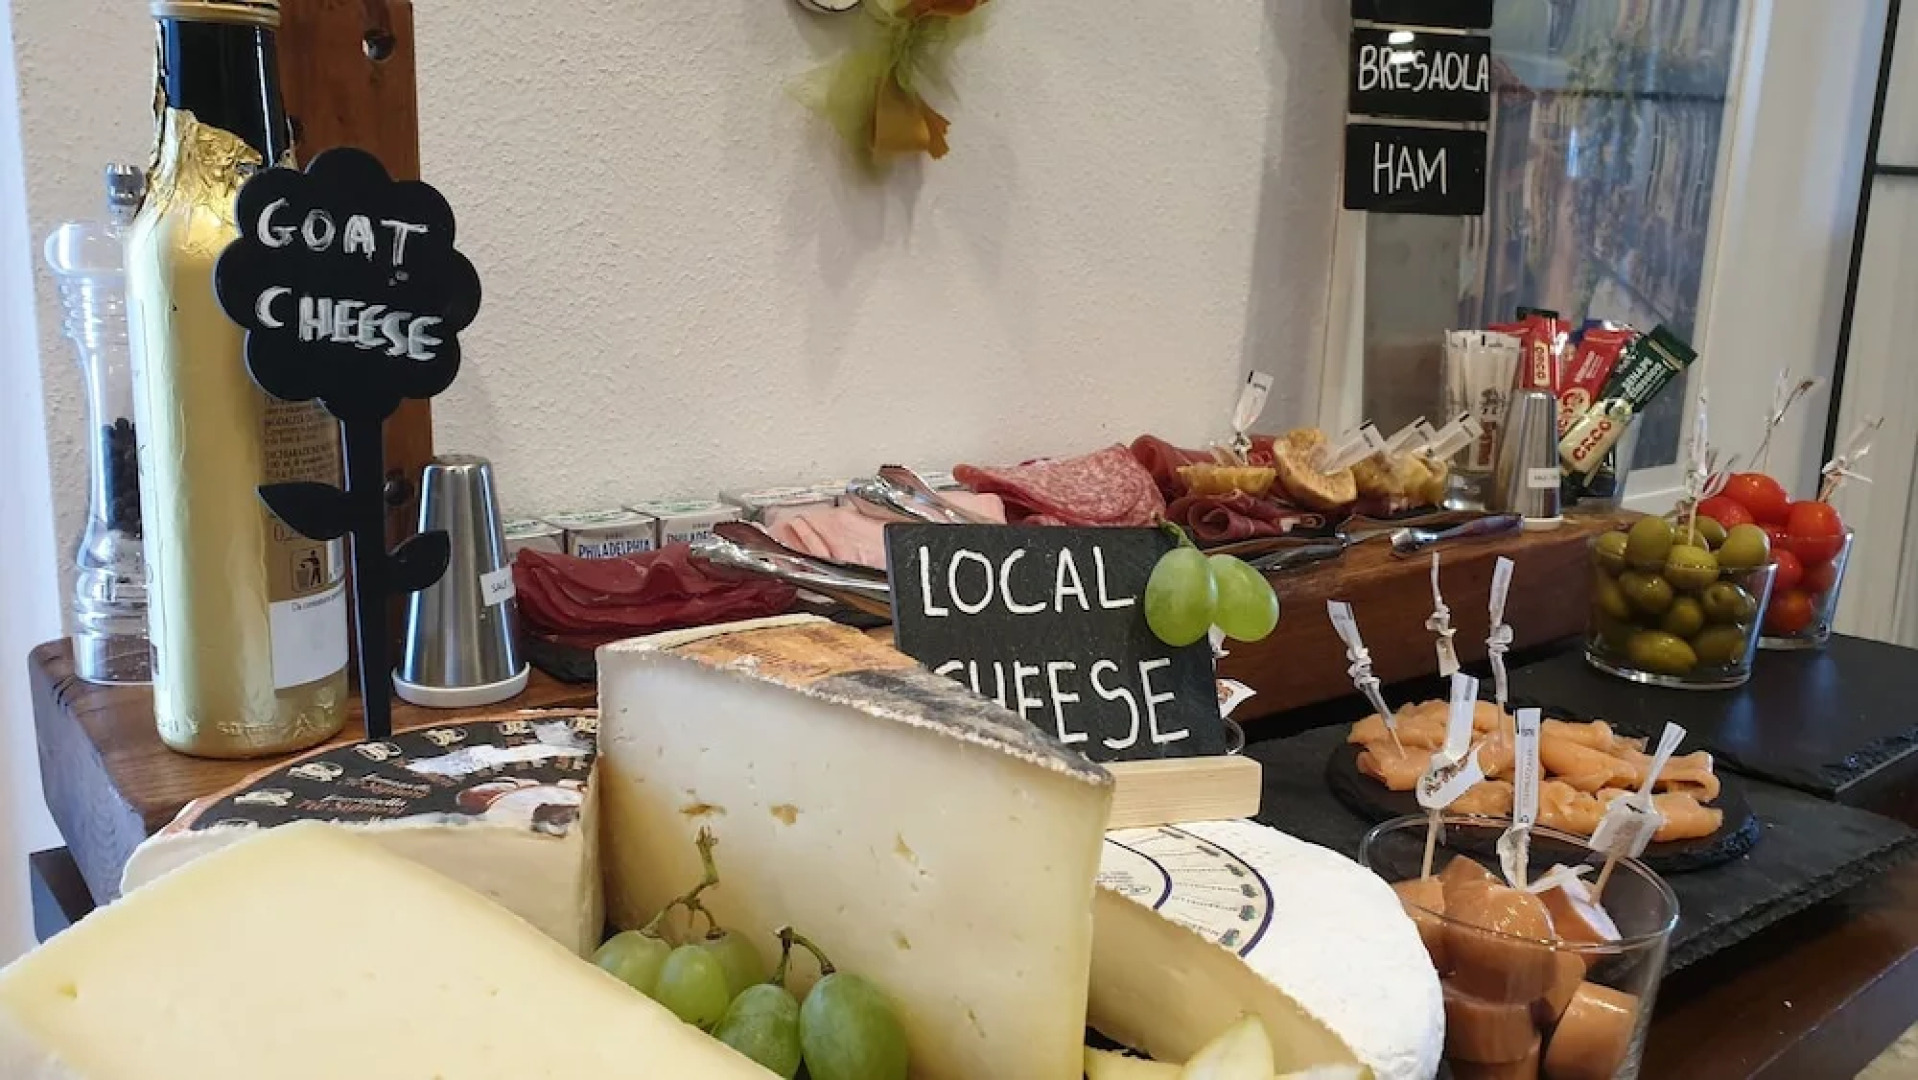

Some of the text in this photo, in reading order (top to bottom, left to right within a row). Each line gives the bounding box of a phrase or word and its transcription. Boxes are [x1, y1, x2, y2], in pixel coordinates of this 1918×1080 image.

[1357, 44, 1490, 93] BRESAOLA
[1372, 141, 1447, 195] HAM
[256, 197, 430, 267] GOAT
[254, 285, 444, 362] CHEESE
[578, 538, 650, 558] PHILADELPHIA
[918, 545, 1137, 618] LOCAL
[932, 656, 1191, 751] EESE
